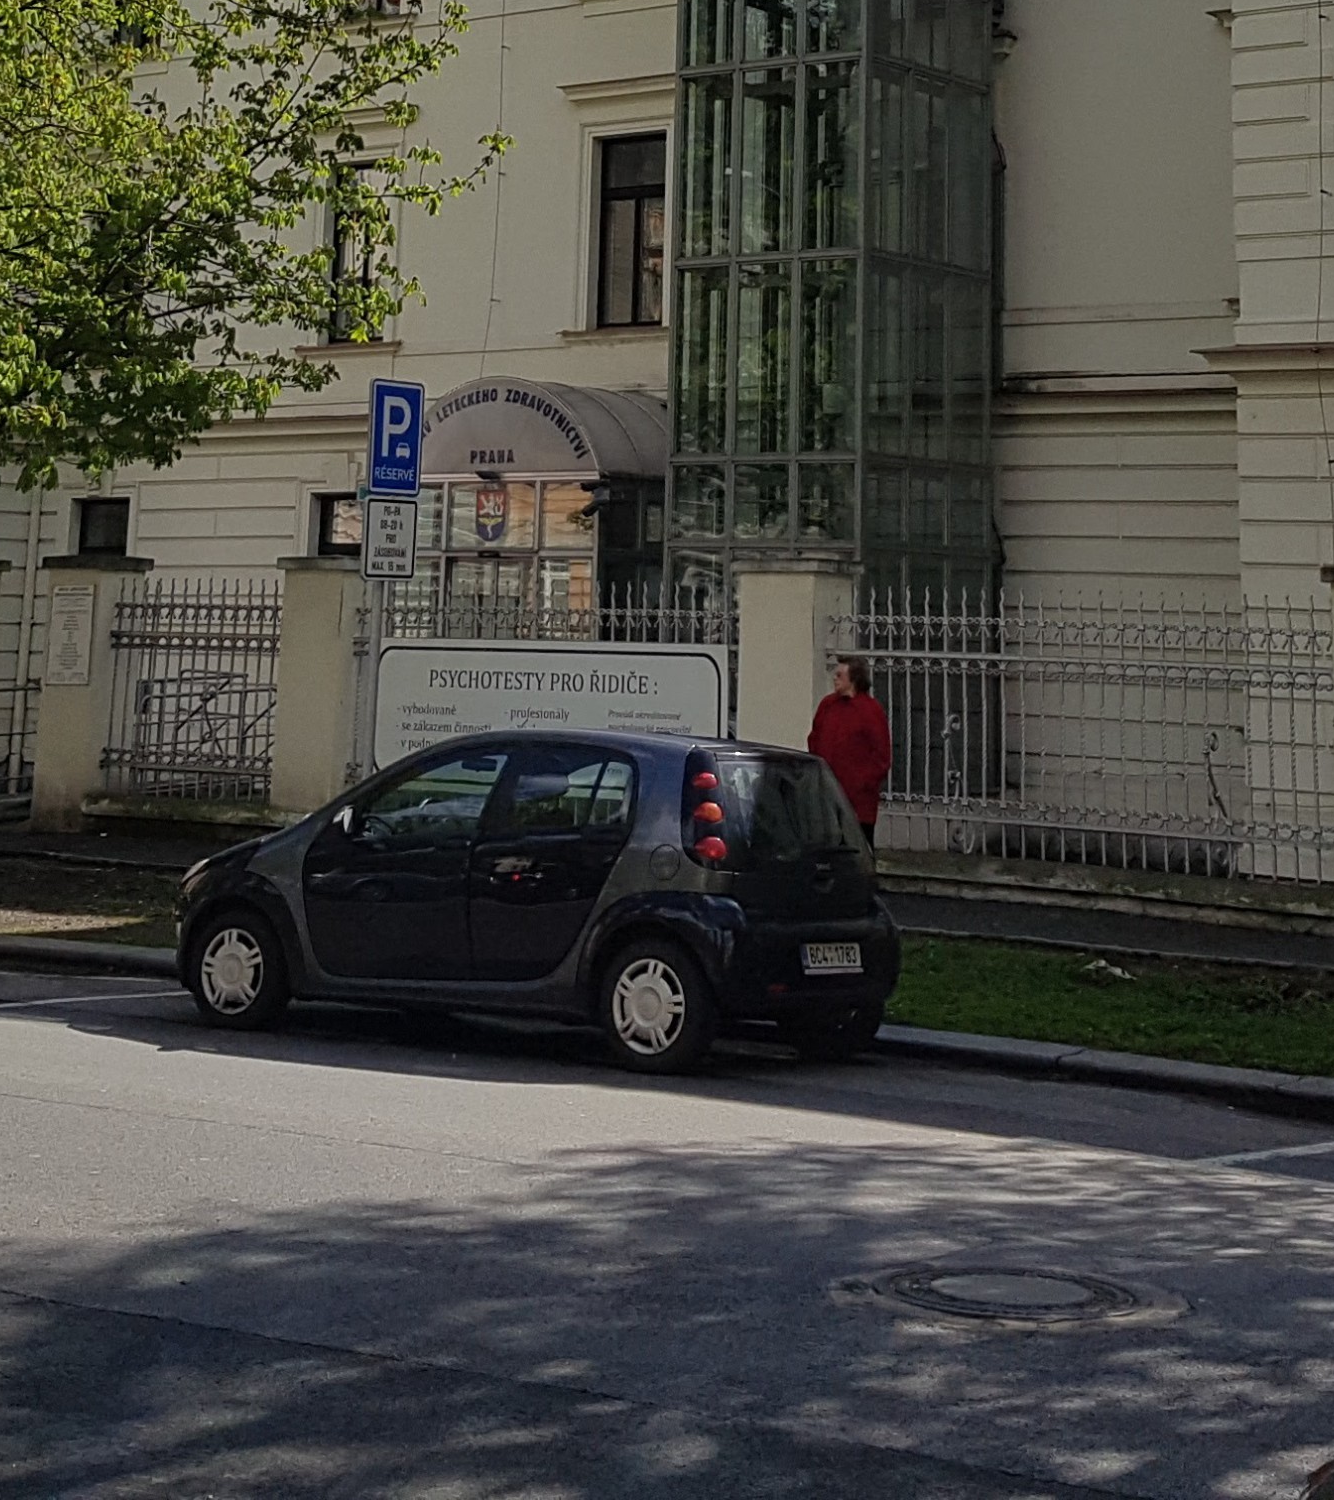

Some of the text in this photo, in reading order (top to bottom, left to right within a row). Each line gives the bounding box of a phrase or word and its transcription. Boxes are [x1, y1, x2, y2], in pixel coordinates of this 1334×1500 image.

[381, 395, 412, 457] P
[505, 388, 591, 460] ZDRAVOTNICTVÍ
[470, 449, 515, 464] PRAHA
[374, 464, 415, 482] RÉSERVÉ
[386, 533, 397, 544] PRO
[429, 669, 546, 691] PSYCHOTESTY
[550, 673, 584, 693] PRO
[590, 669, 649, 695] ŘIDIČE
[402, 719, 492, 734] se zákazem činnosti
